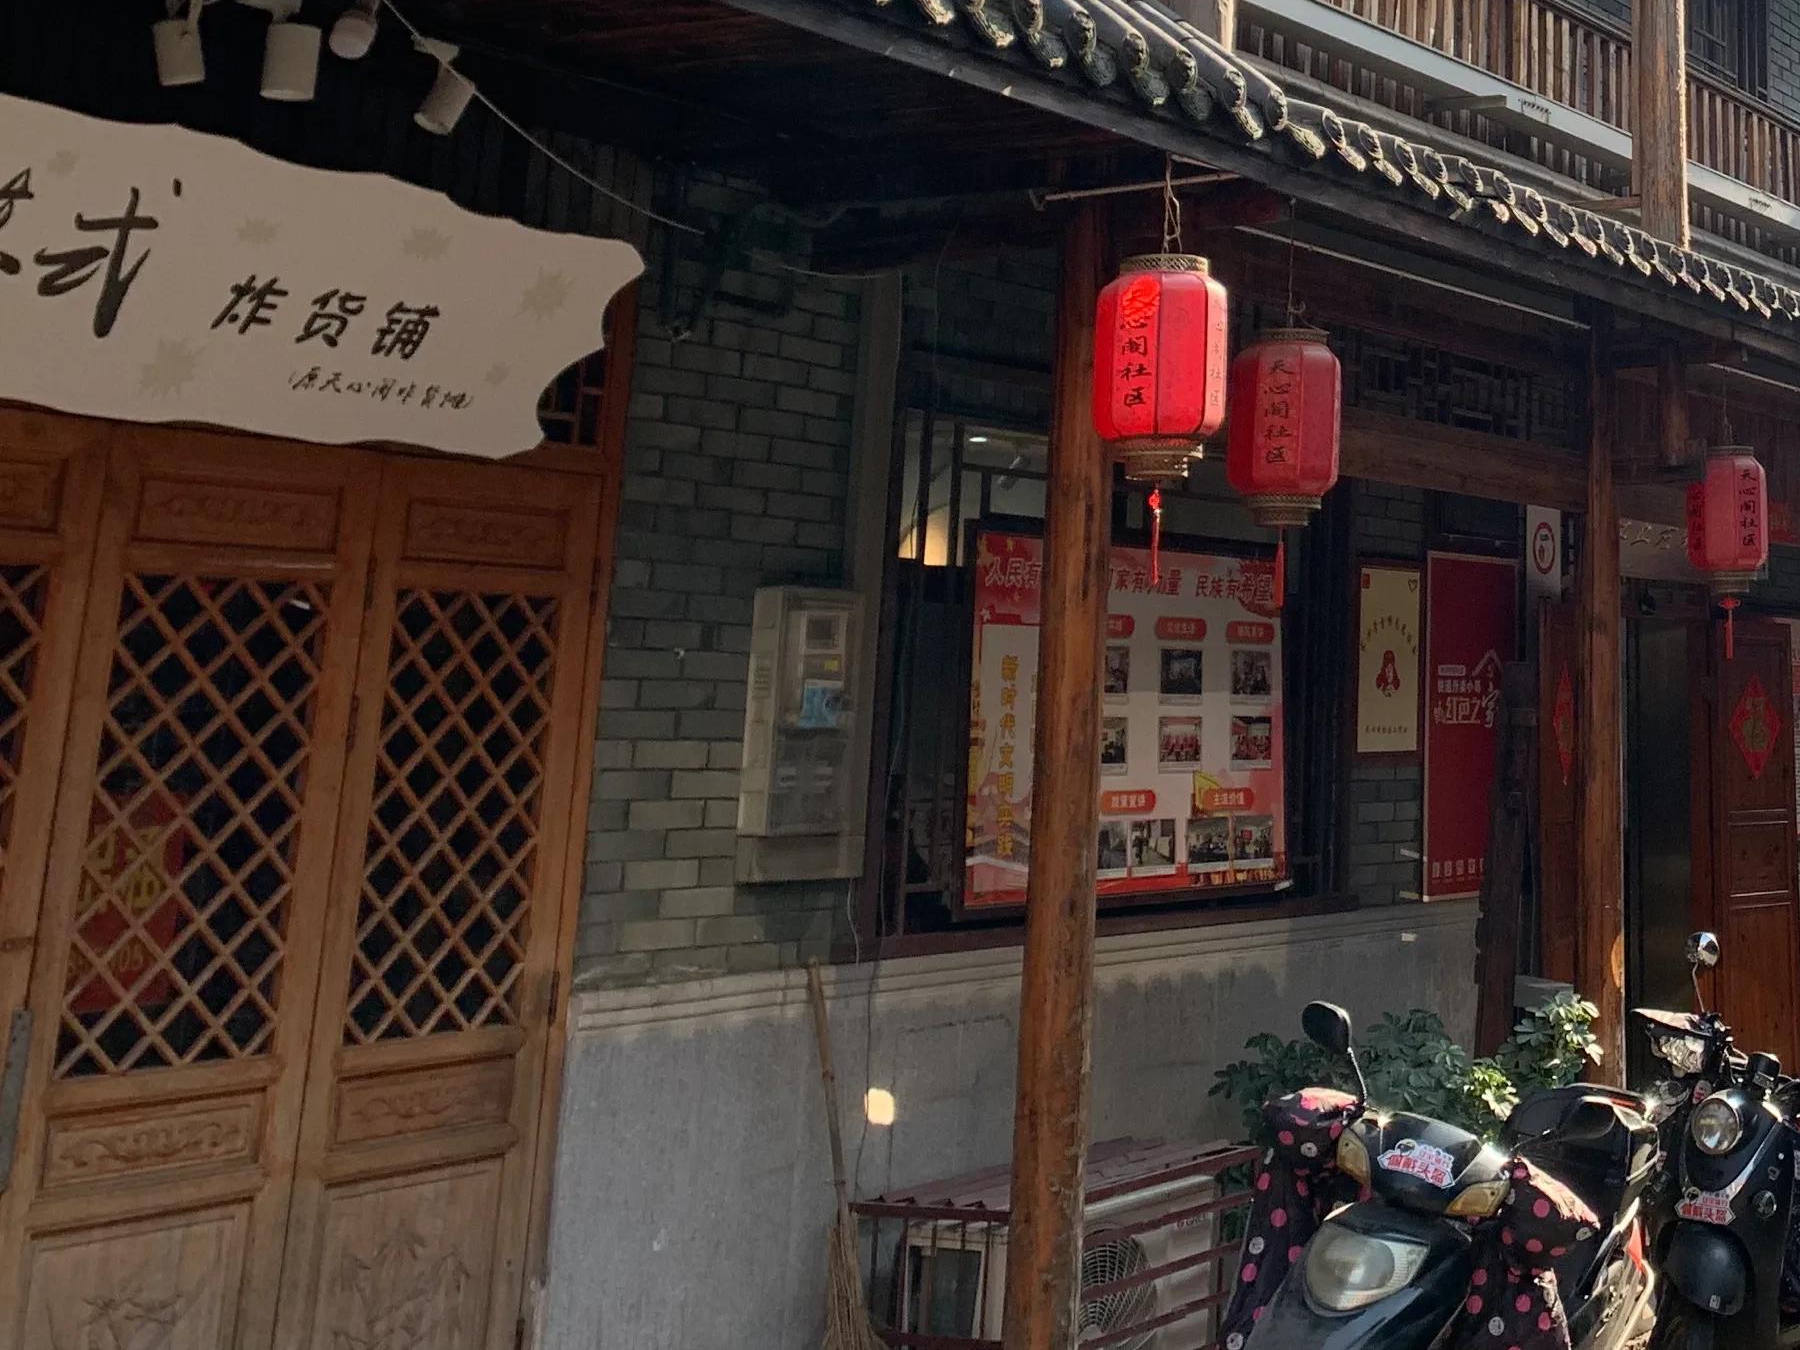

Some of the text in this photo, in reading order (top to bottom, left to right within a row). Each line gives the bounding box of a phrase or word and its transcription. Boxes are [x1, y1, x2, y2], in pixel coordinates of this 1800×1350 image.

[210, 274, 441, 360] 炸货铺
[1263, 358, 1295, 464] 天心阁社区
[1737, 468, 1759, 548] 天心阁社区
[1108, 567, 1182, 597] 家有力量
[1196, 572, 1272, 602] 民族有希望
